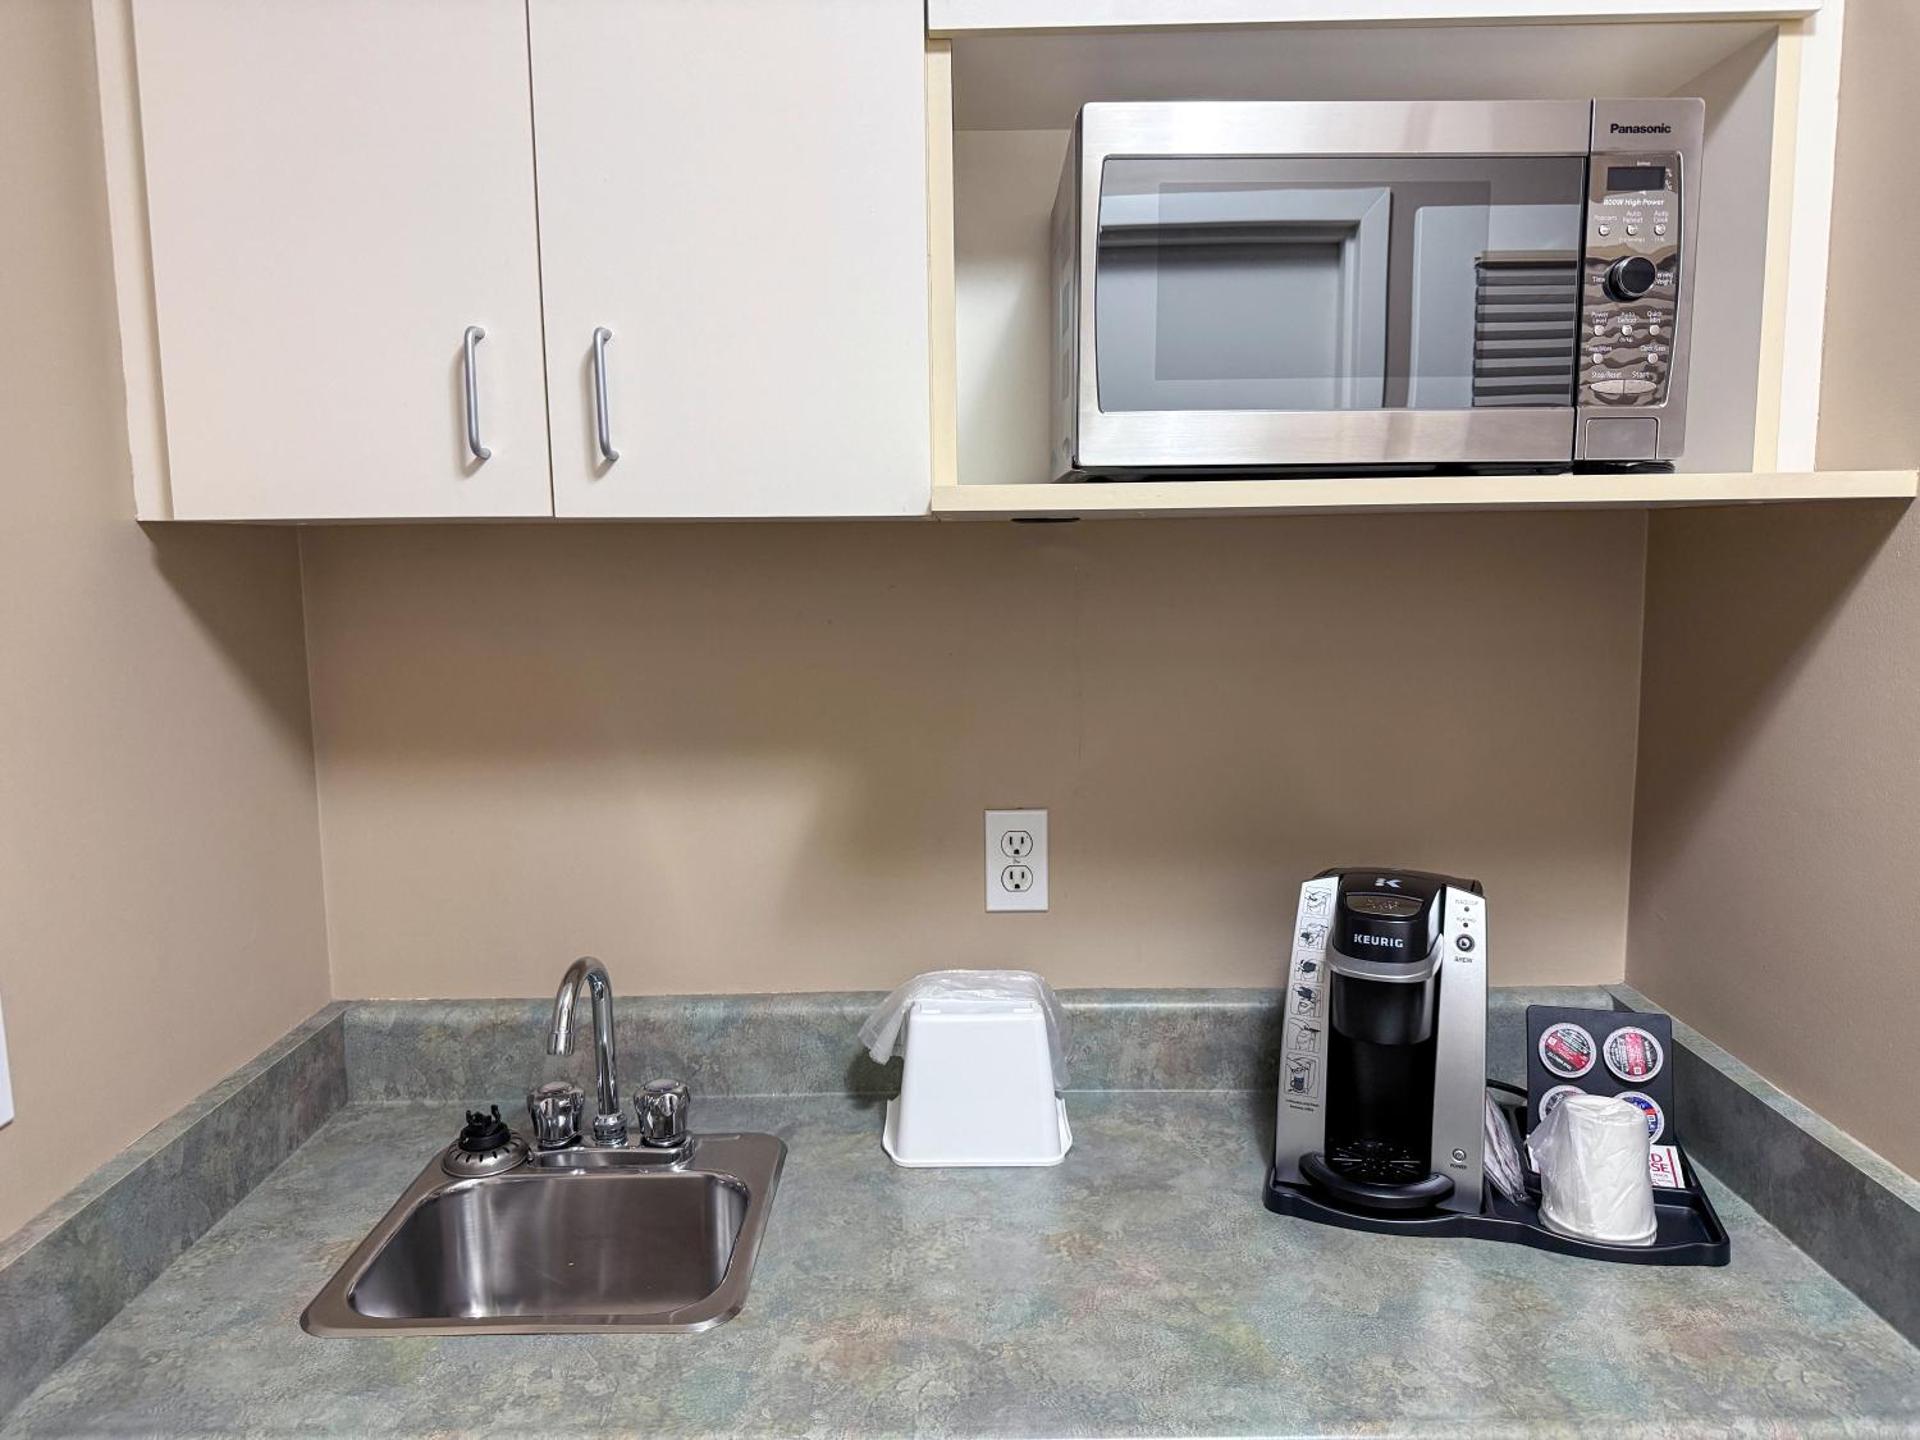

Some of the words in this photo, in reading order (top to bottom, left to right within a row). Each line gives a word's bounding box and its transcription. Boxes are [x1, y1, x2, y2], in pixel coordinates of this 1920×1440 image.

[1610, 123, 1672, 134] Panasonic
[1624, 198, 1641, 208] High
[1642, 198, 1664, 206] Power
[1632, 370, 1650, 378] Start
[1354, 933, 1404, 948] KEURIG
